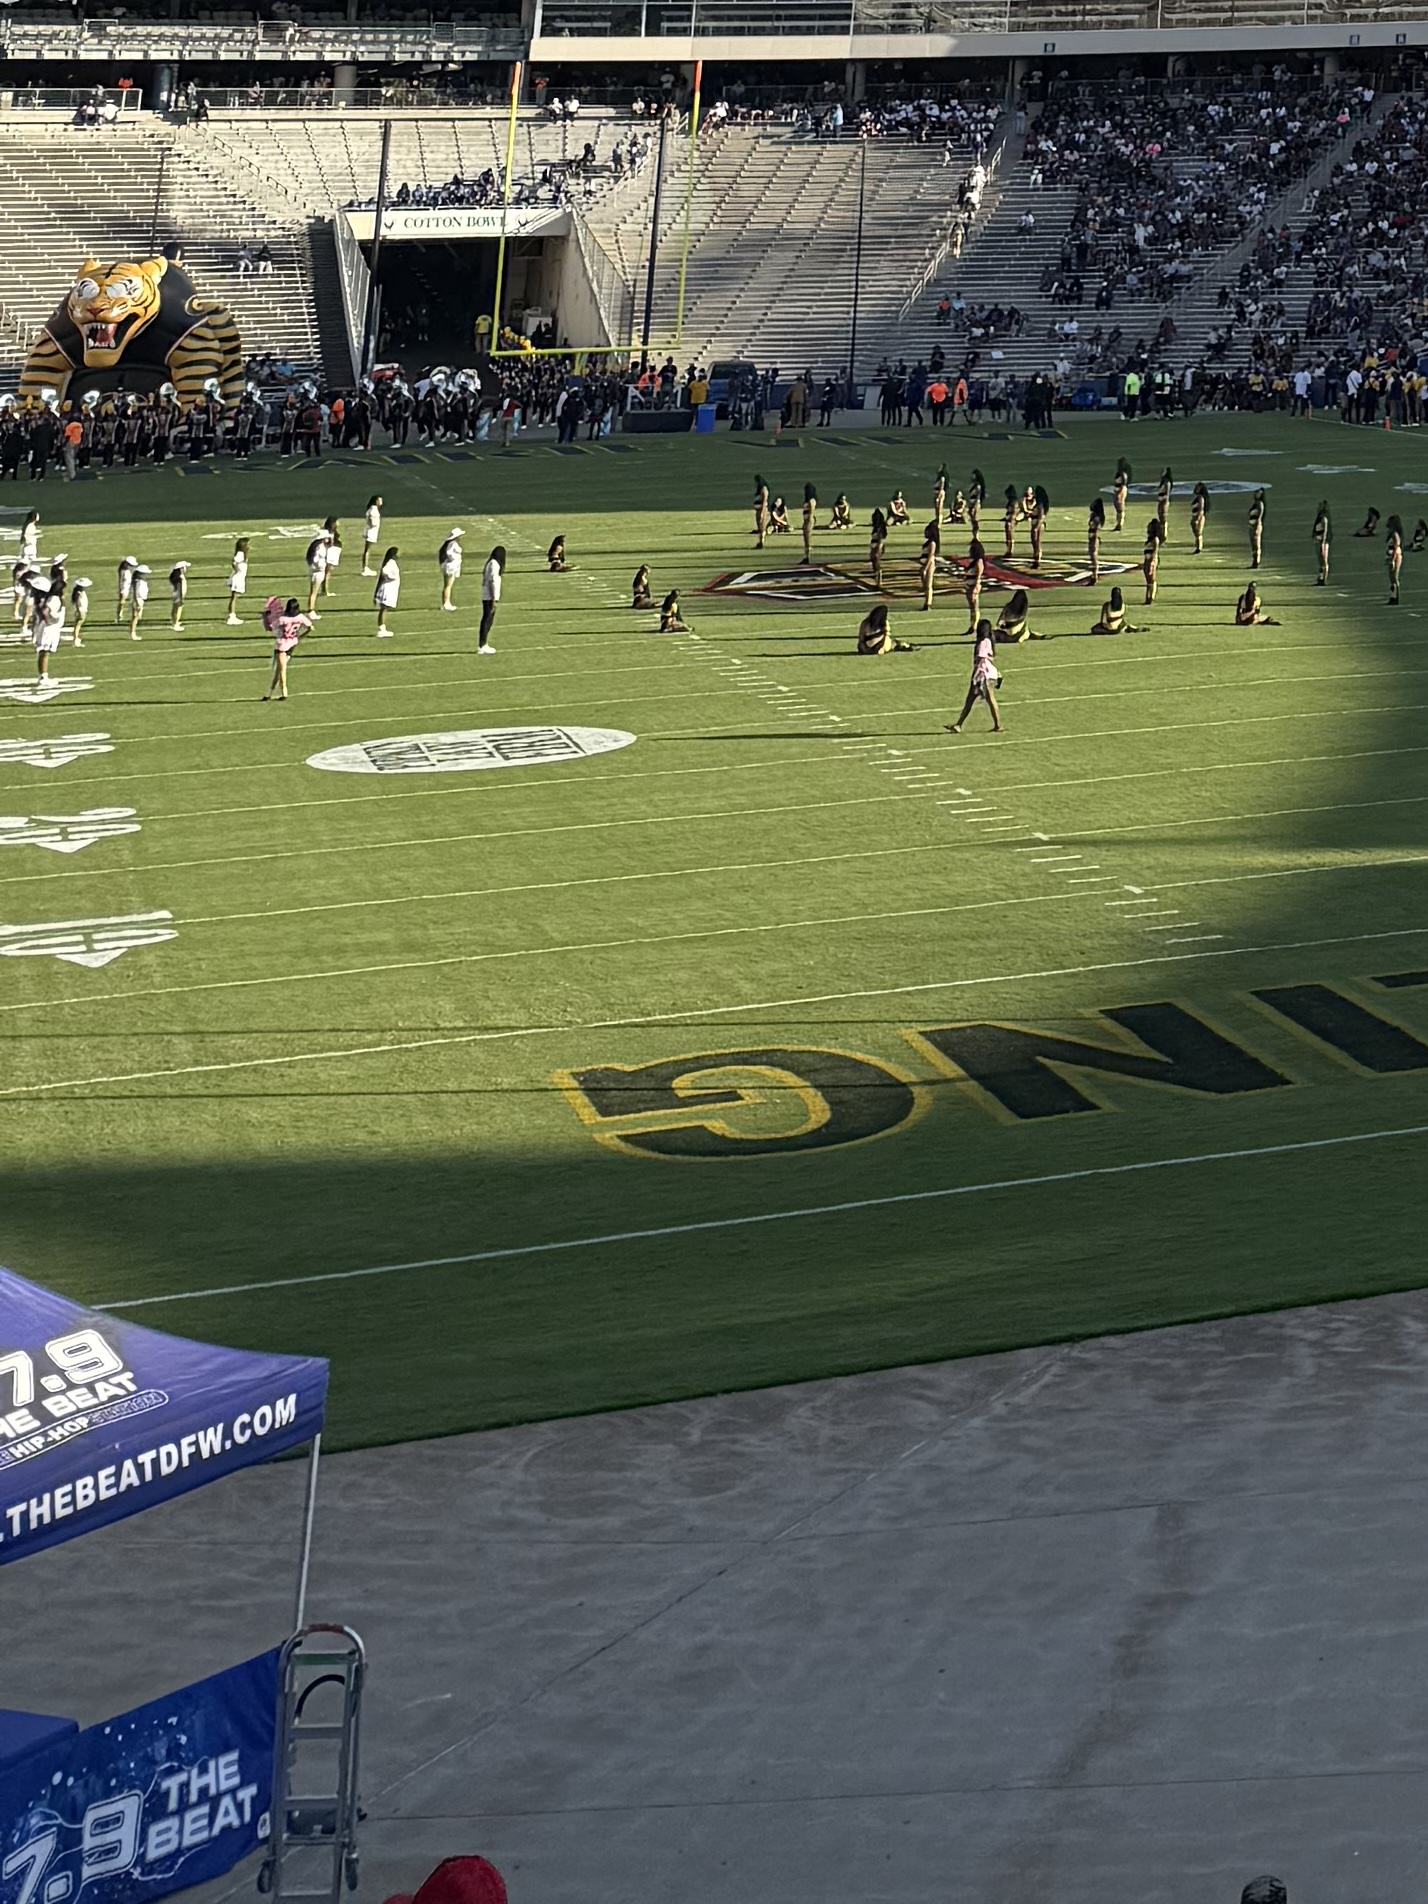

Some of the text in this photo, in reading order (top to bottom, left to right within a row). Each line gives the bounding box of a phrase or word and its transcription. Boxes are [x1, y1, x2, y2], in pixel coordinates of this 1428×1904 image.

[403, 216, 463, 229] COTTON
[42, 1371, 138, 1418] BEAT
[160, 1749, 241, 1813] THE
[145, 1783, 258, 1863] BEAT
